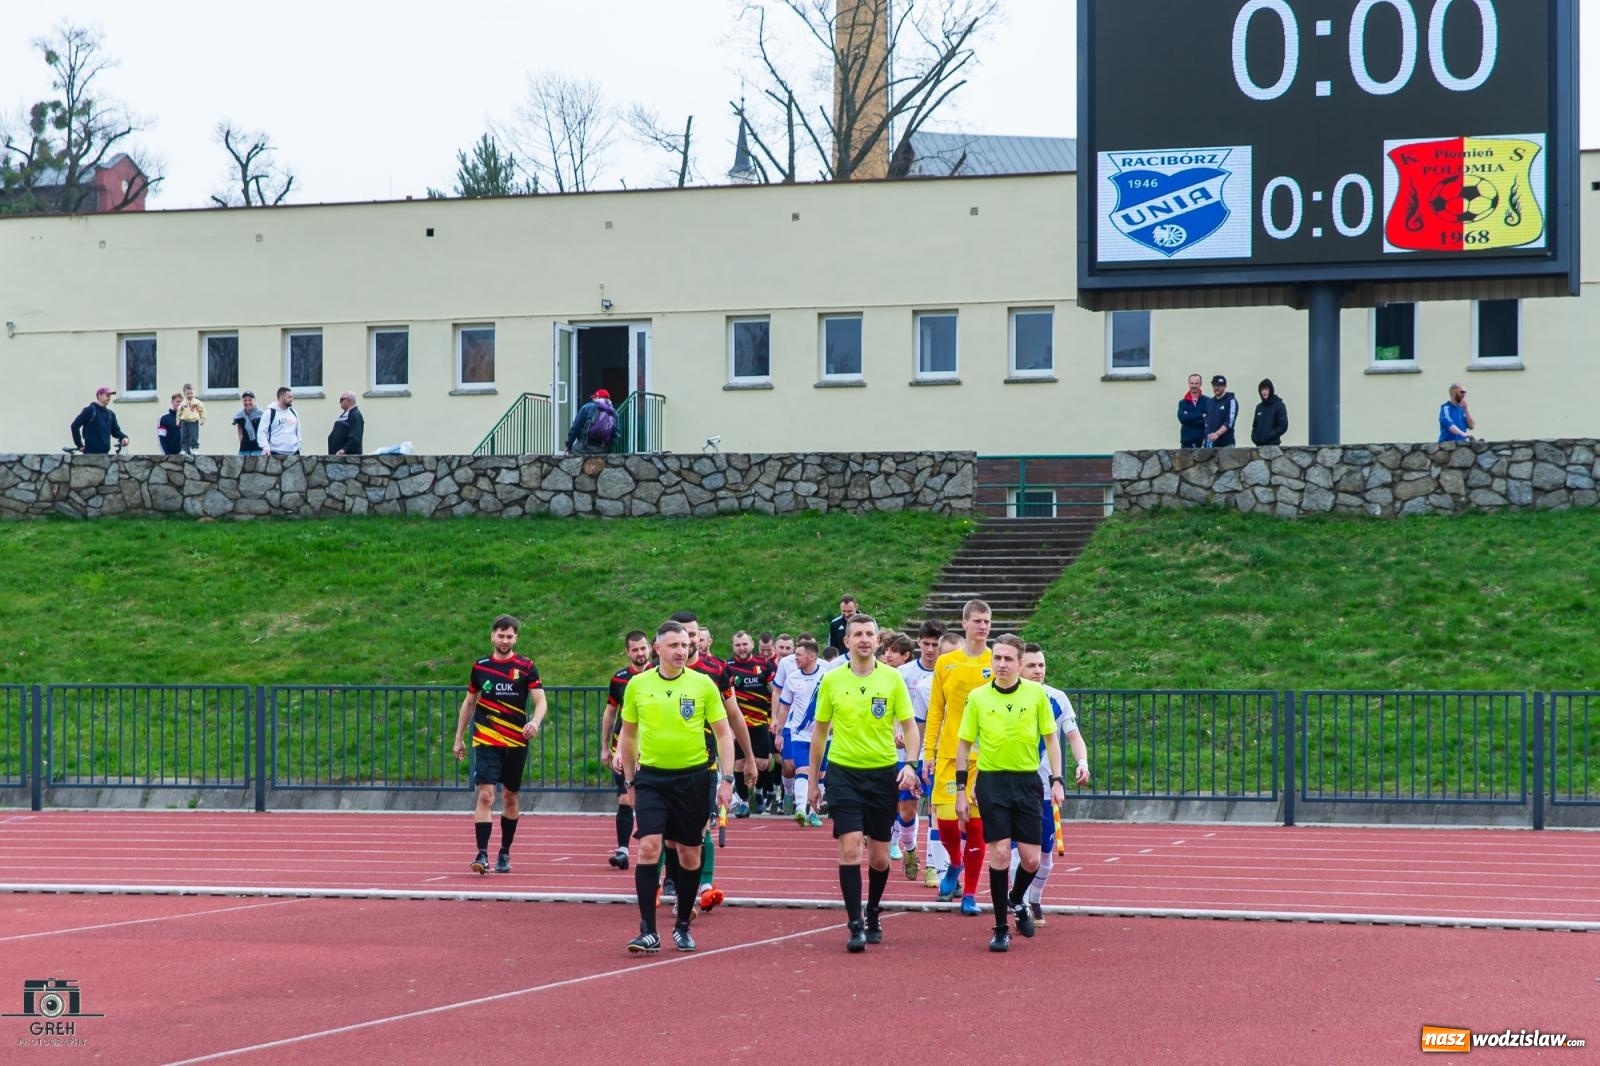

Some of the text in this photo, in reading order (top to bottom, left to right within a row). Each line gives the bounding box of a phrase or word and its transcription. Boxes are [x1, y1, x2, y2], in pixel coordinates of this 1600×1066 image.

[1232, 0, 1498, 100] 0:00
[1121, 153, 1218, 167] RACIBÓRZ
[1509, 147, 1526, 161] S
[1128, 178, 1158, 189] 1946
[1121, 186, 1213, 226] UNIA
[1262, 173, 1374, 239] 0:0
[1440, 230, 1490, 245] 1968
[495, 682, 513, 691] CUK
